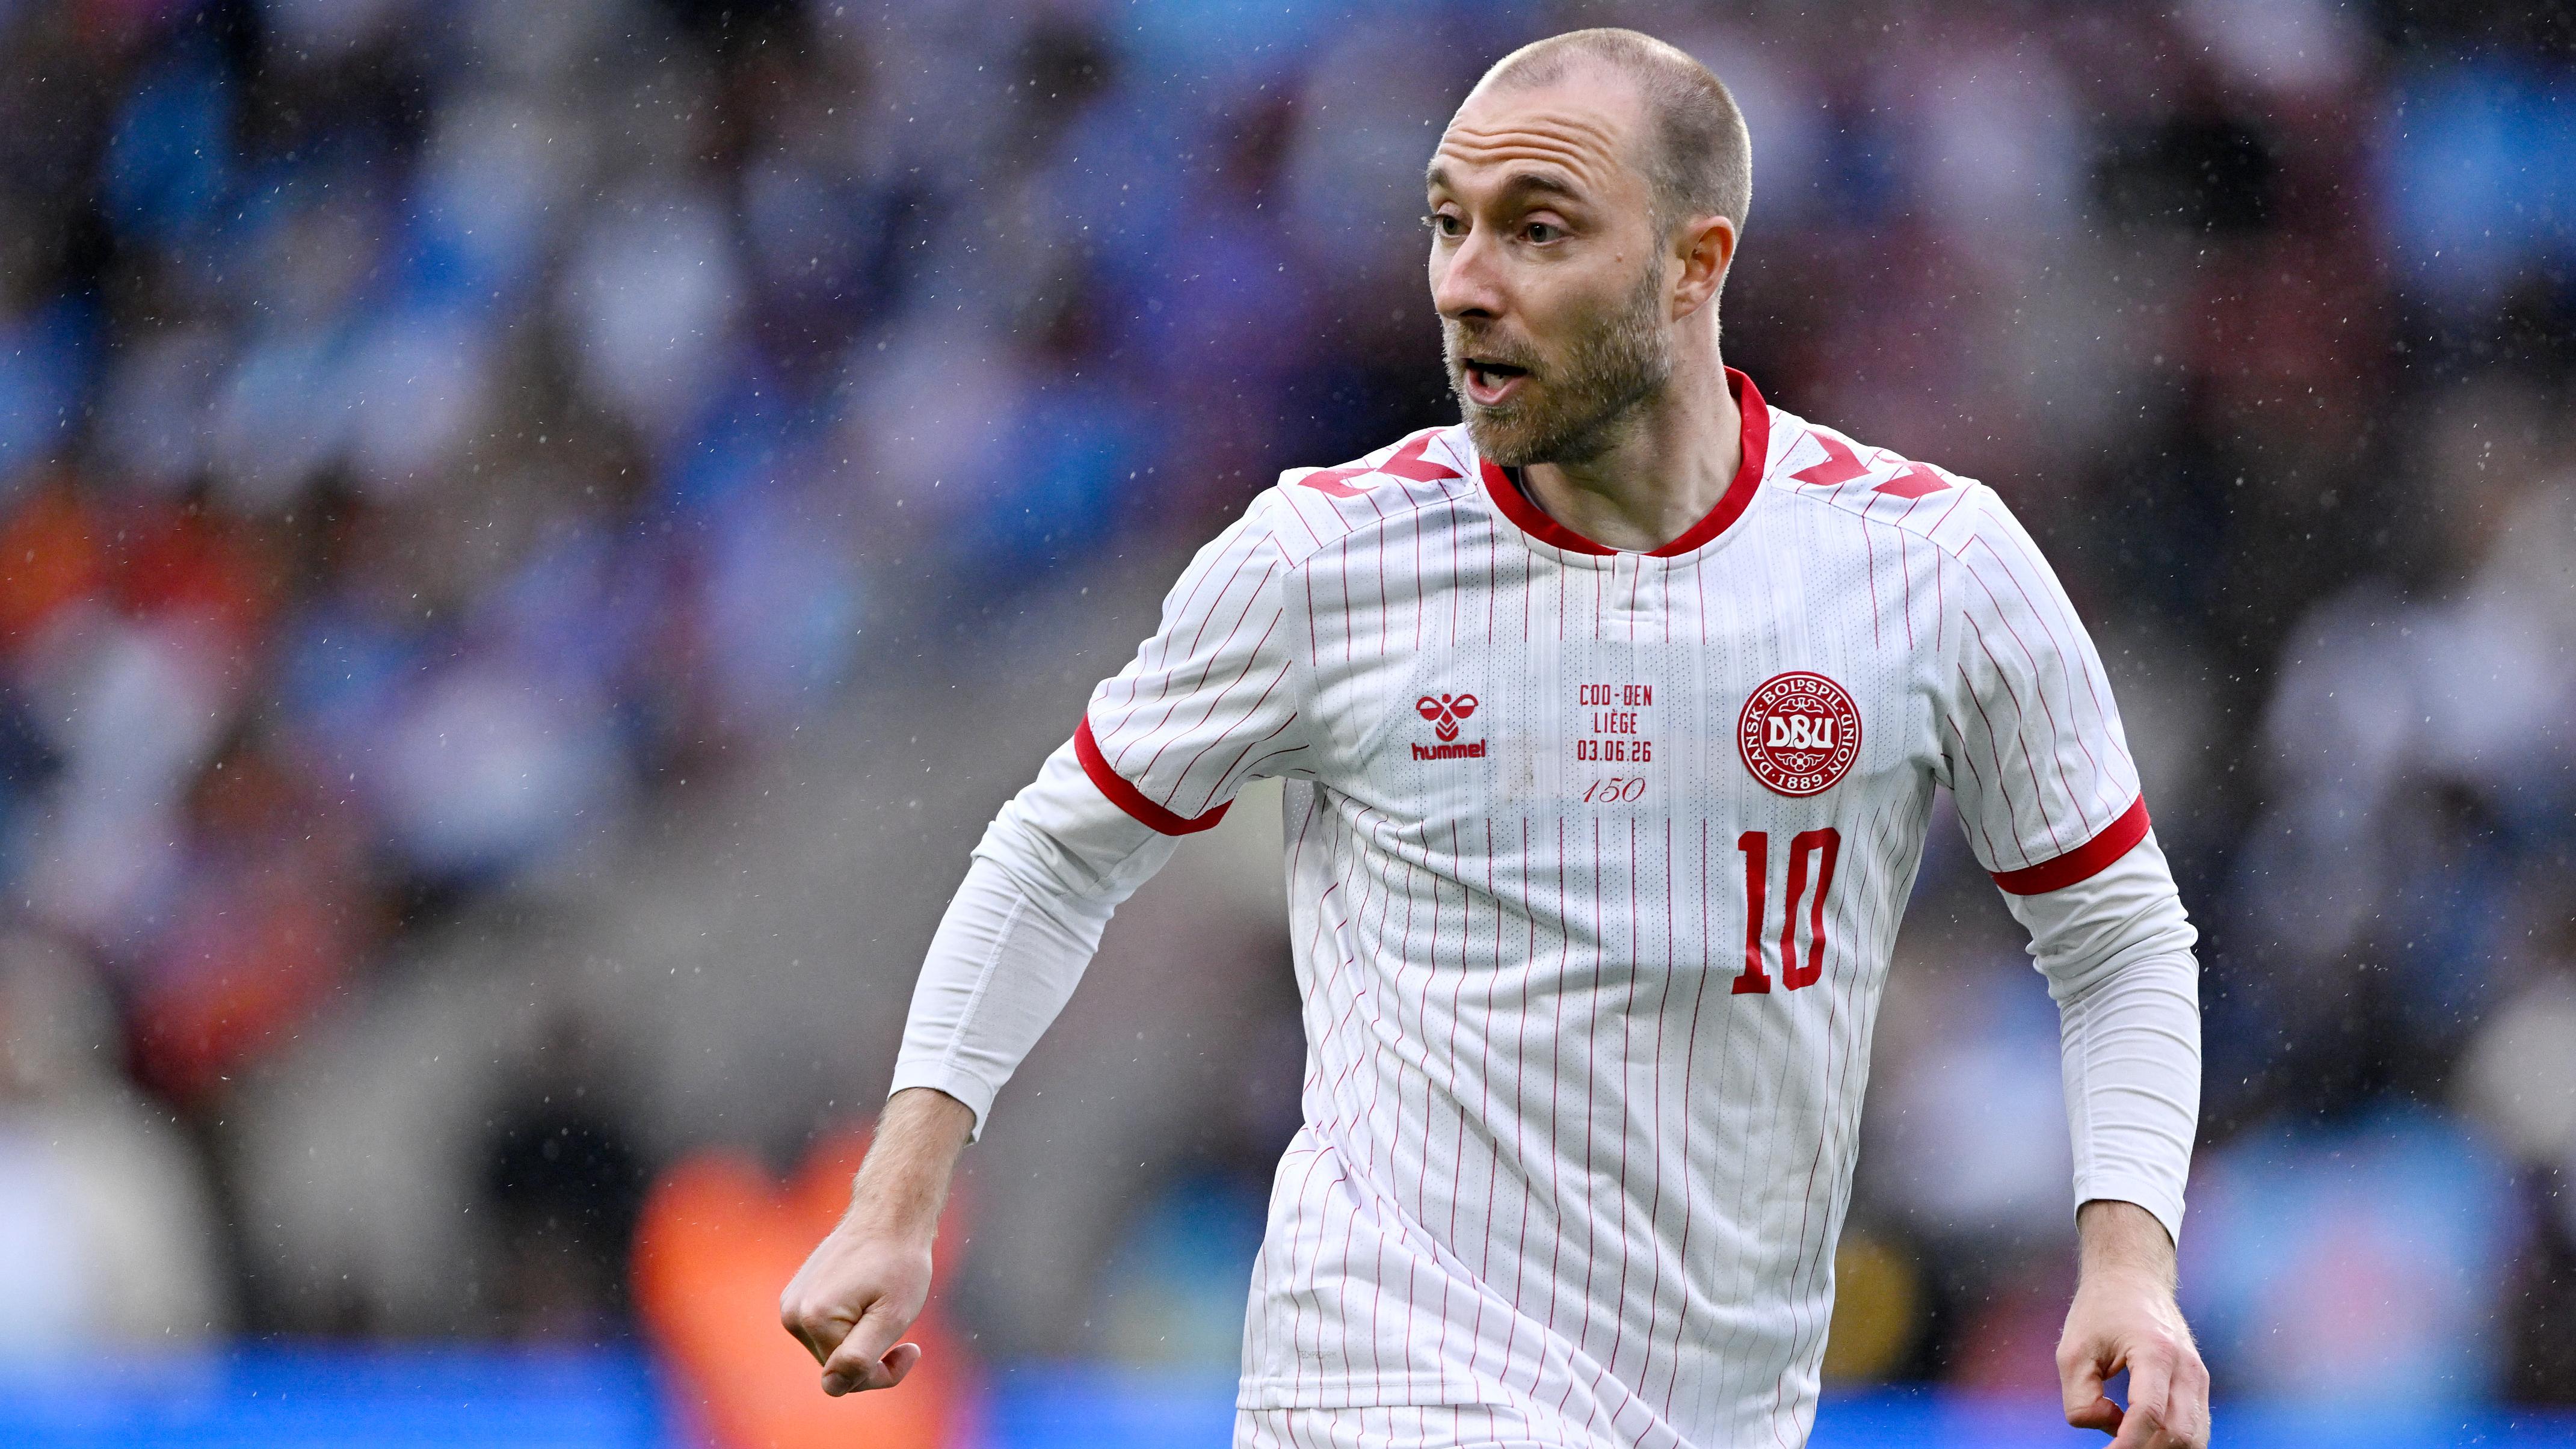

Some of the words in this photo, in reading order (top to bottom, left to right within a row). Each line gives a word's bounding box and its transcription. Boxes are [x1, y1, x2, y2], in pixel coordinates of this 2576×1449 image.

[1594, 709, 1638, 734] LIÈGE
[1766, 714, 1835, 749] DBU
[1411, 739, 1485, 761] hummel
[1577, 740, 1651, 762] 03.06.26
[1746, 706, 1773, 776] DANSK
[1583, 777, 1646, 803] 150
[1776, 774, 1823, 789] 1889
[1731, 826, 1841, 995] 10
